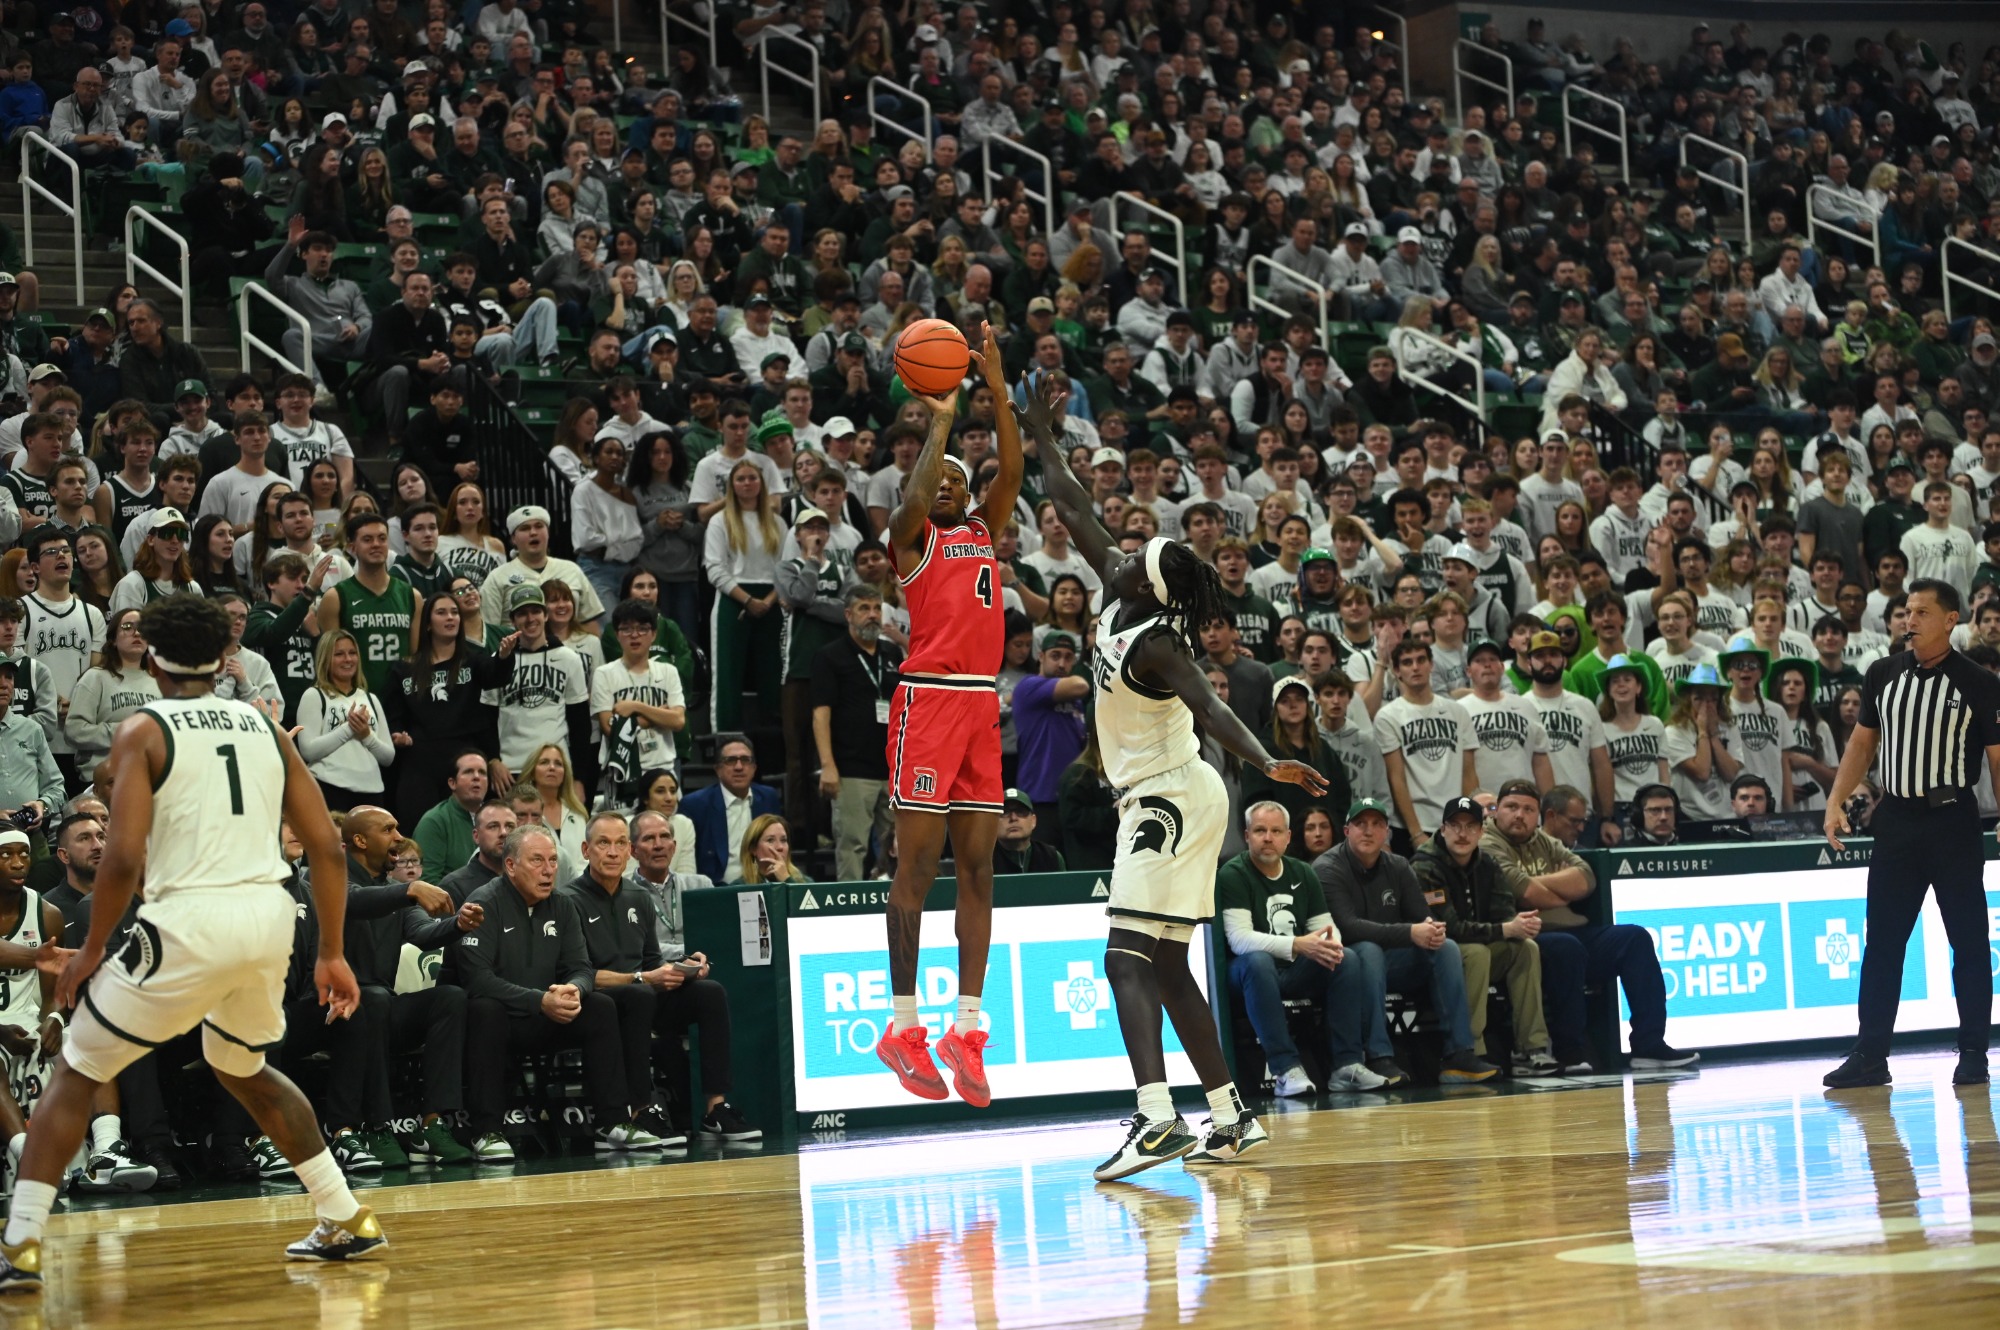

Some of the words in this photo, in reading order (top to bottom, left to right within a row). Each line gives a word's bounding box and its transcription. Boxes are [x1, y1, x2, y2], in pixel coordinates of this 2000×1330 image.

[448, 547, 502, 570] IZZON
[974, 564, 993, 609] 4
[351, 612, 410, 629] SPARTANS
[35, 626, 89, 655] State
[367, 633, 400, 661] 22
[286, 649, 316, 680] 23
[170, 709, 234, 733] FEARS
[239, 714, 269, 736] JR.
[1401, 717, 1459, 748] IZZONE
[1471, 710, 1529, 741] ZZONE
[1538, 710, 1584, 741] ZONE
[216, 743, 244, 816] 1
[823, 962, 991, 1014] RED
[1683, 960, 1768, 998] HELP
[825, 1017, 879, 1056] TO
[811, 1112, 846, 1129] ANC
